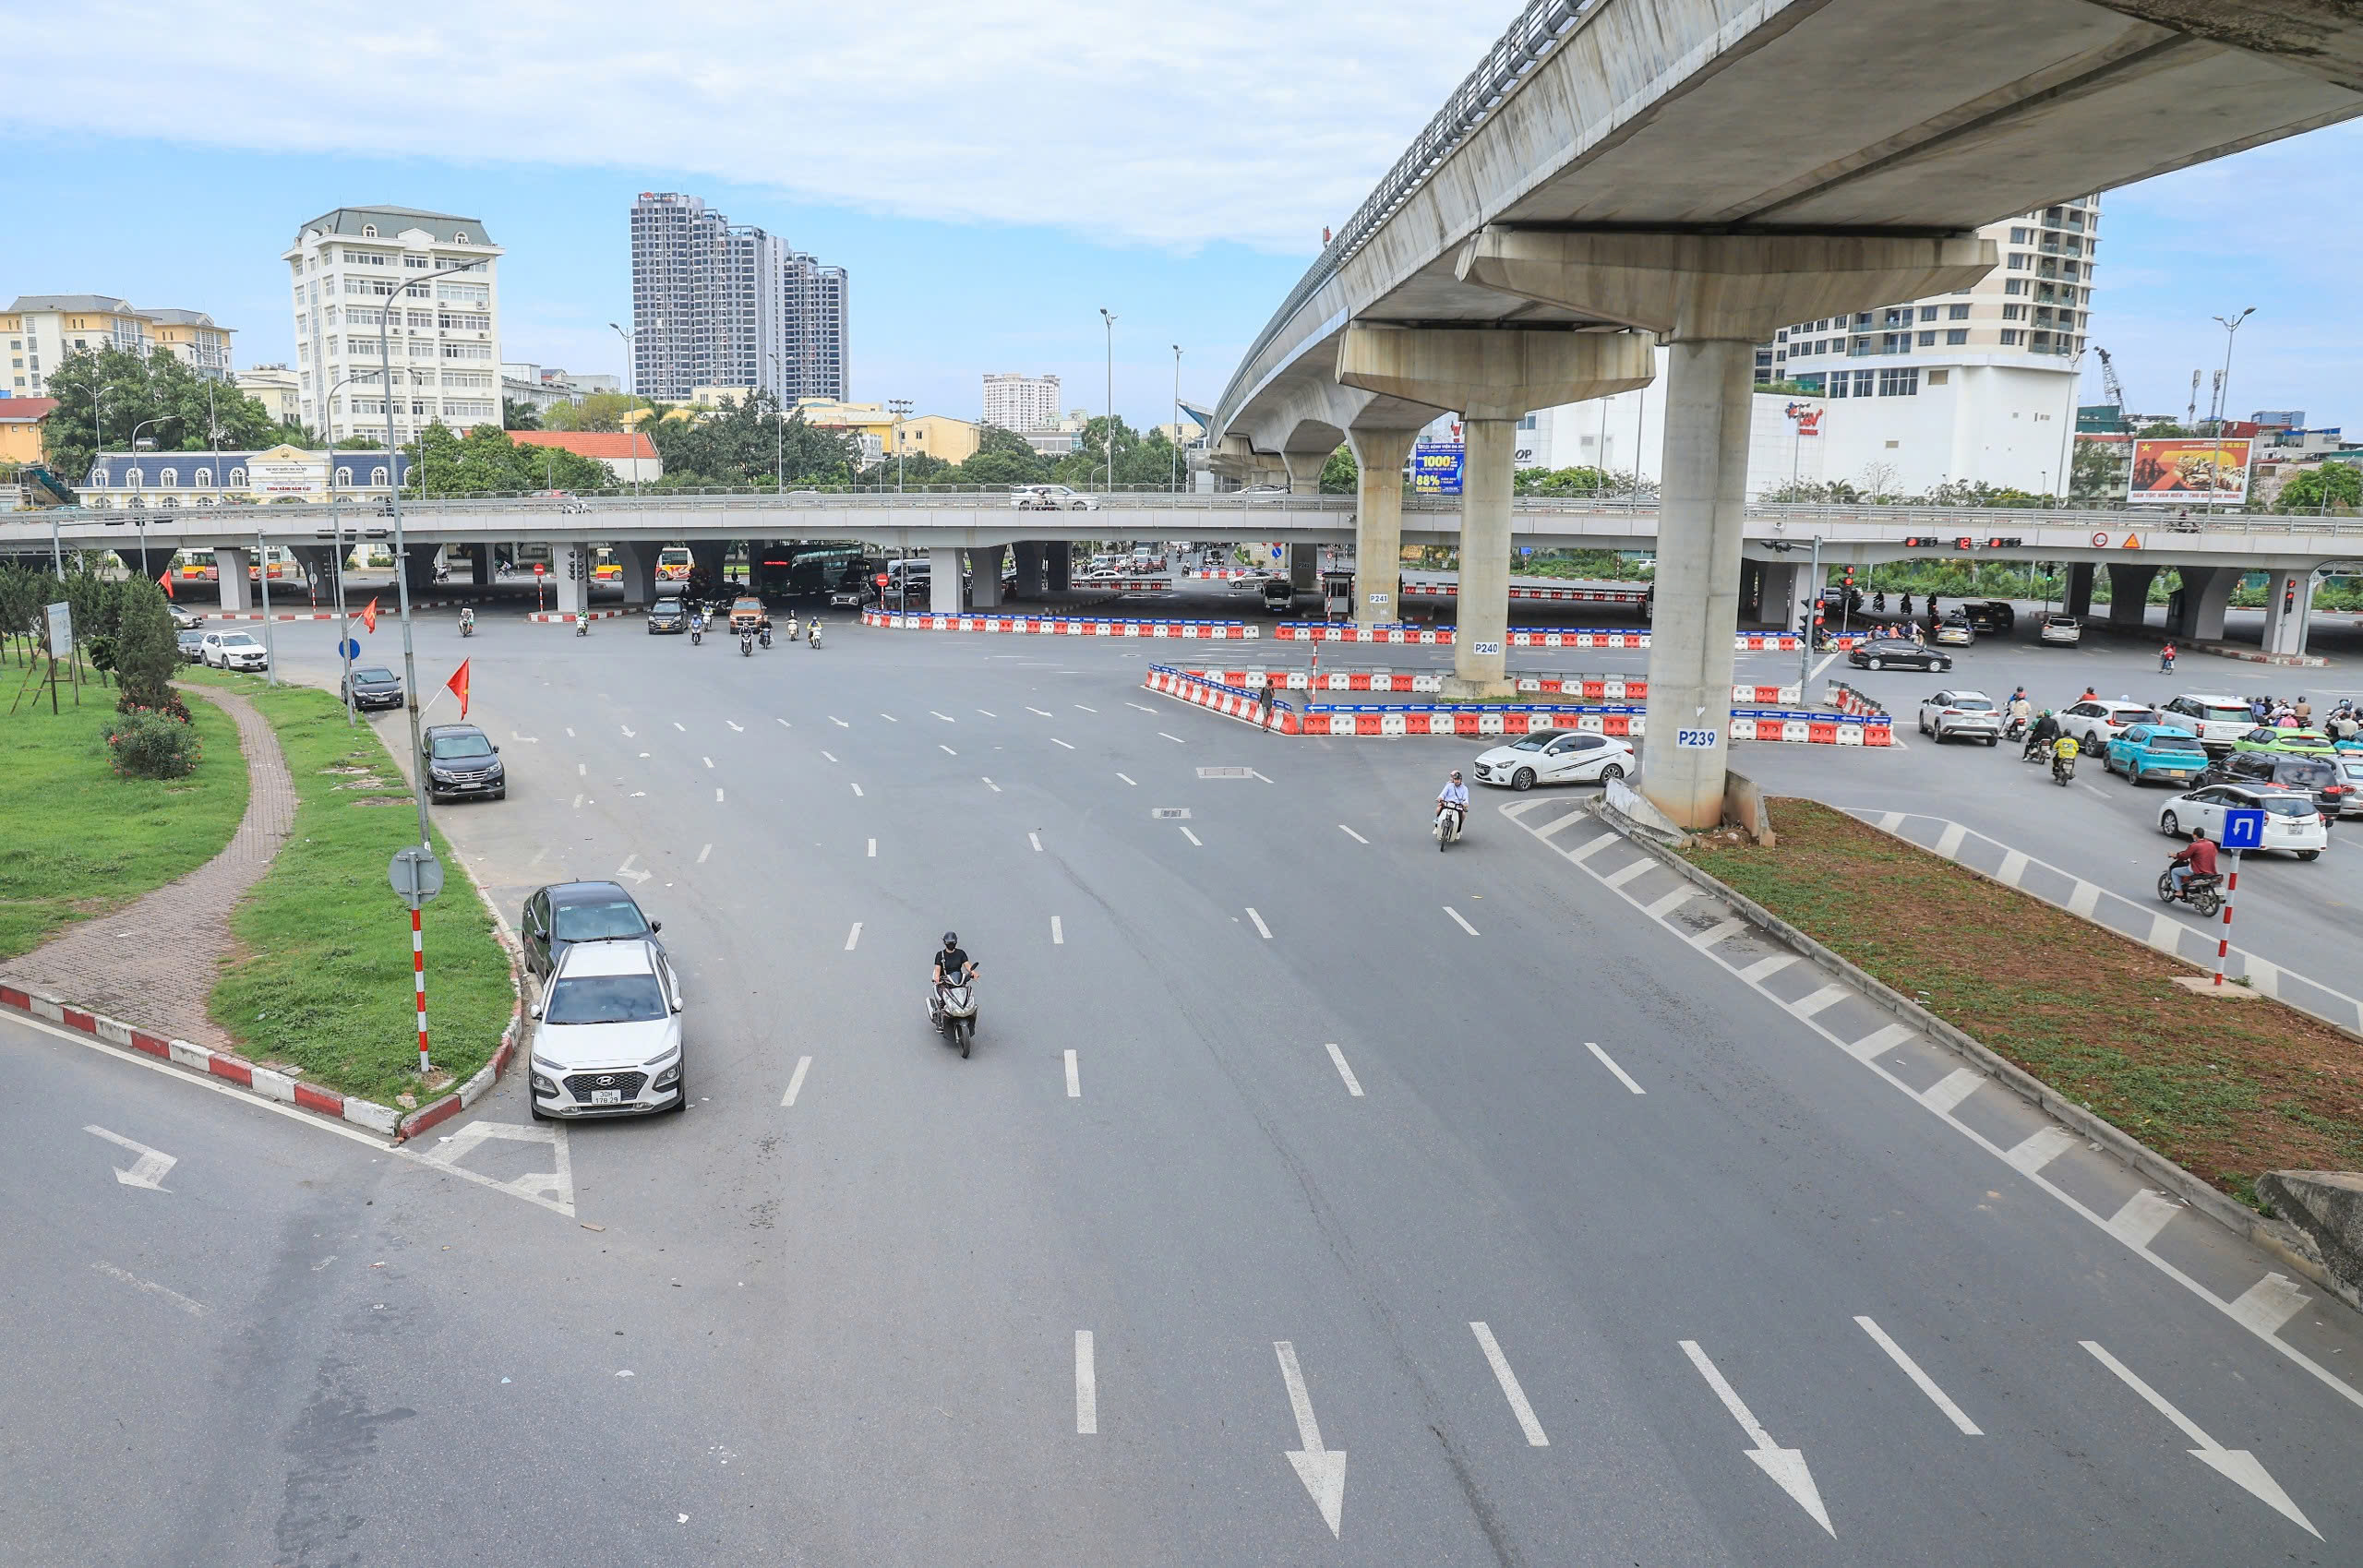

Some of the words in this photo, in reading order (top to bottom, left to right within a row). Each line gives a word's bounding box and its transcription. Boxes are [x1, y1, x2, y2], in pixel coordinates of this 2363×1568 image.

[1416, 474, 1440, 486] 88%
[1476, 643, 1497, 652] P240
[1679, 731, 1715, 746] P239
